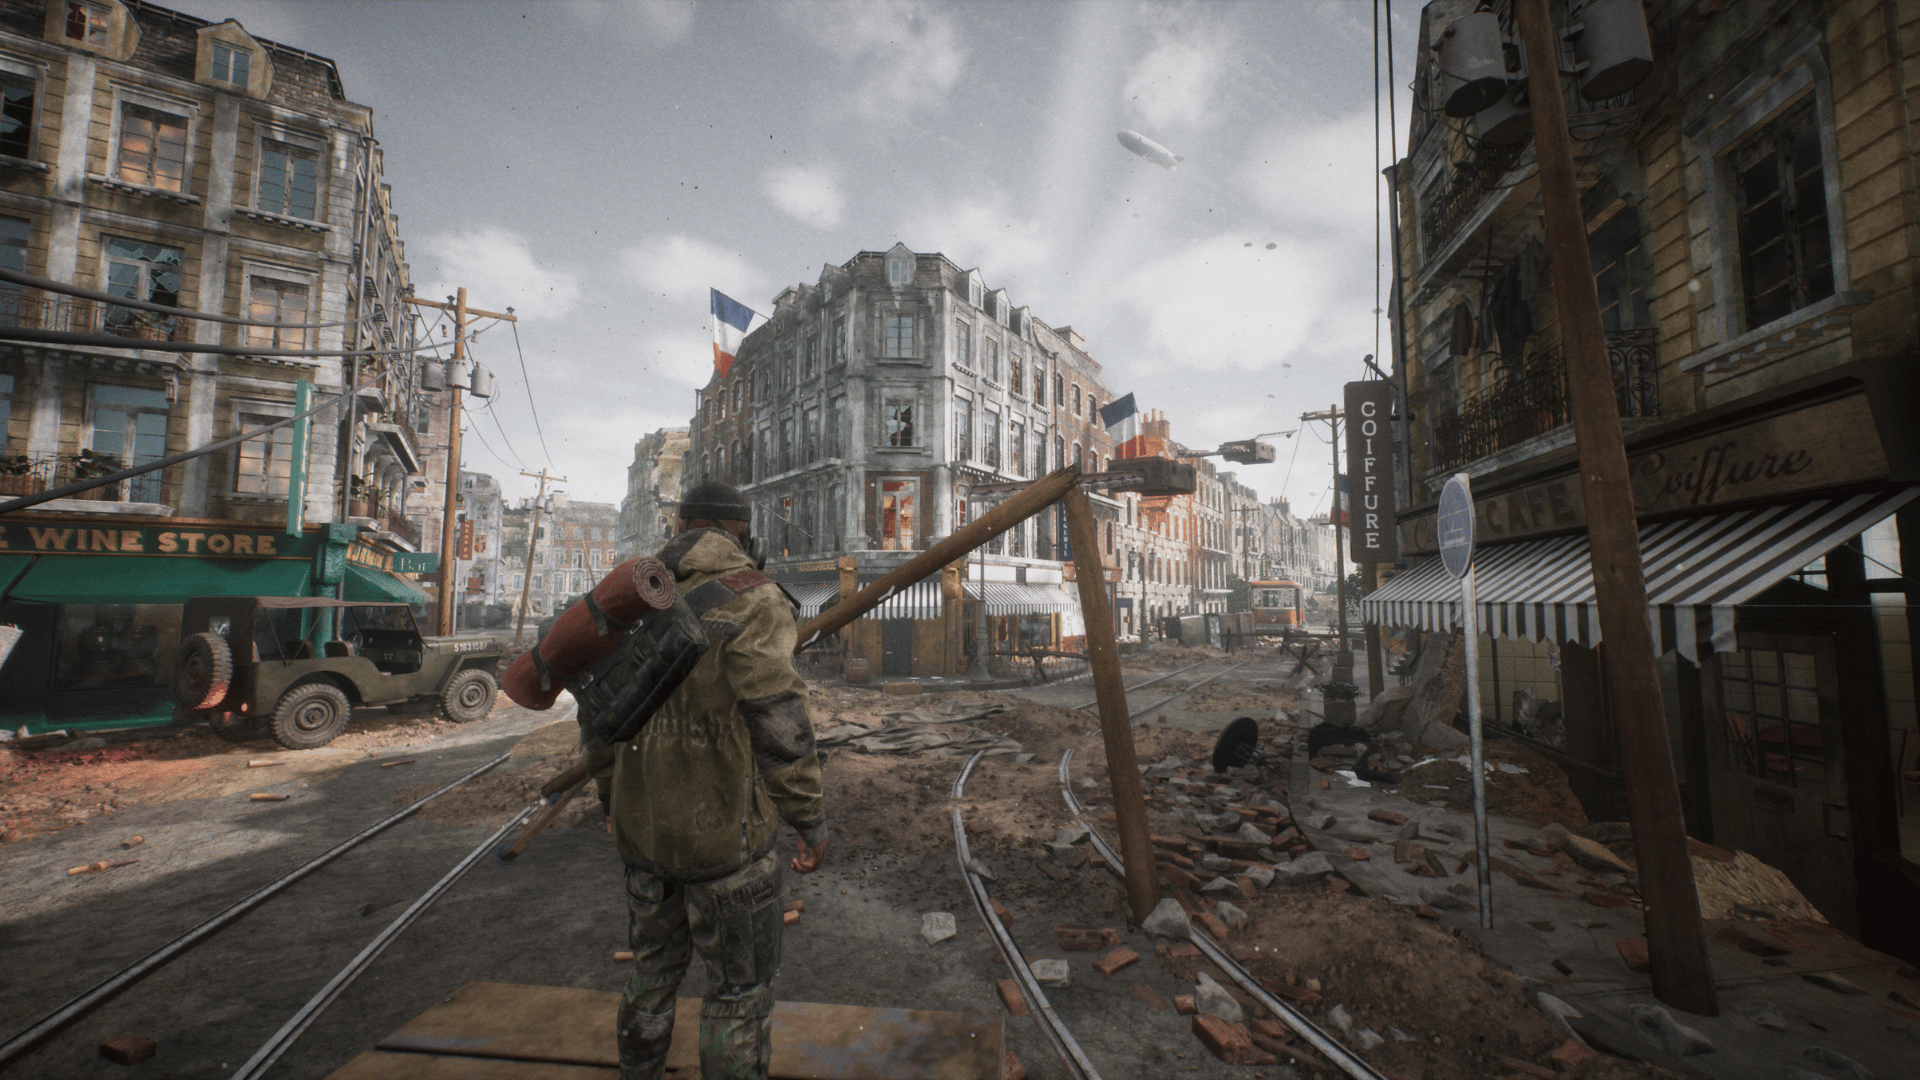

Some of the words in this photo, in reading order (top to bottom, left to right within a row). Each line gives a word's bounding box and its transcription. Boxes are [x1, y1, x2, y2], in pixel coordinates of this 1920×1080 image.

[1361, 401, 1380, 548] COIFFURE
[1630, 441, 1813, 512] Coiffure
[27, 527, 144, 552] WINE
[158, 532, 277, 555] STORE
[400, 557, 430, 572] Bar
